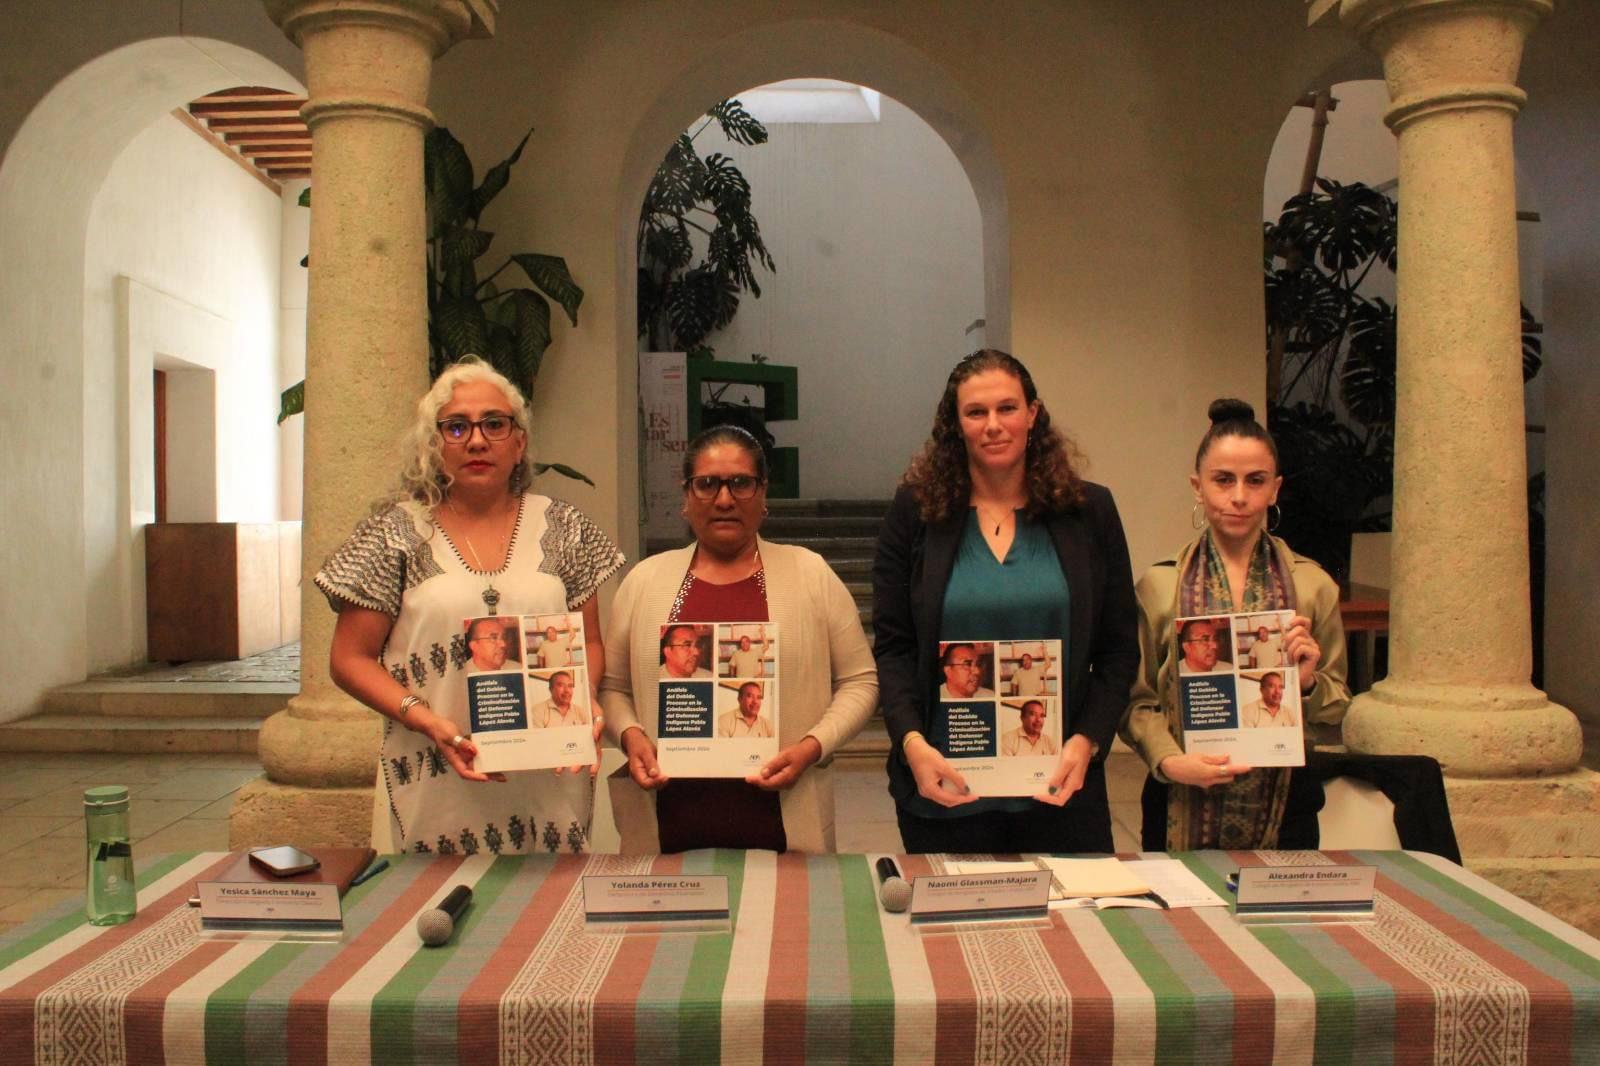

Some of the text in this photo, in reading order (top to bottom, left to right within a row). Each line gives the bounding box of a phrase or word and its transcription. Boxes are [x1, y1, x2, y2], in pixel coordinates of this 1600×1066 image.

[1269, 872, 1314, 880] Alexandra
[611, 881, 650, 889] Yolanda
[960, 877, 1038, 887] Glassman-Majara
[252, 887, 288, 896] Sánchez
